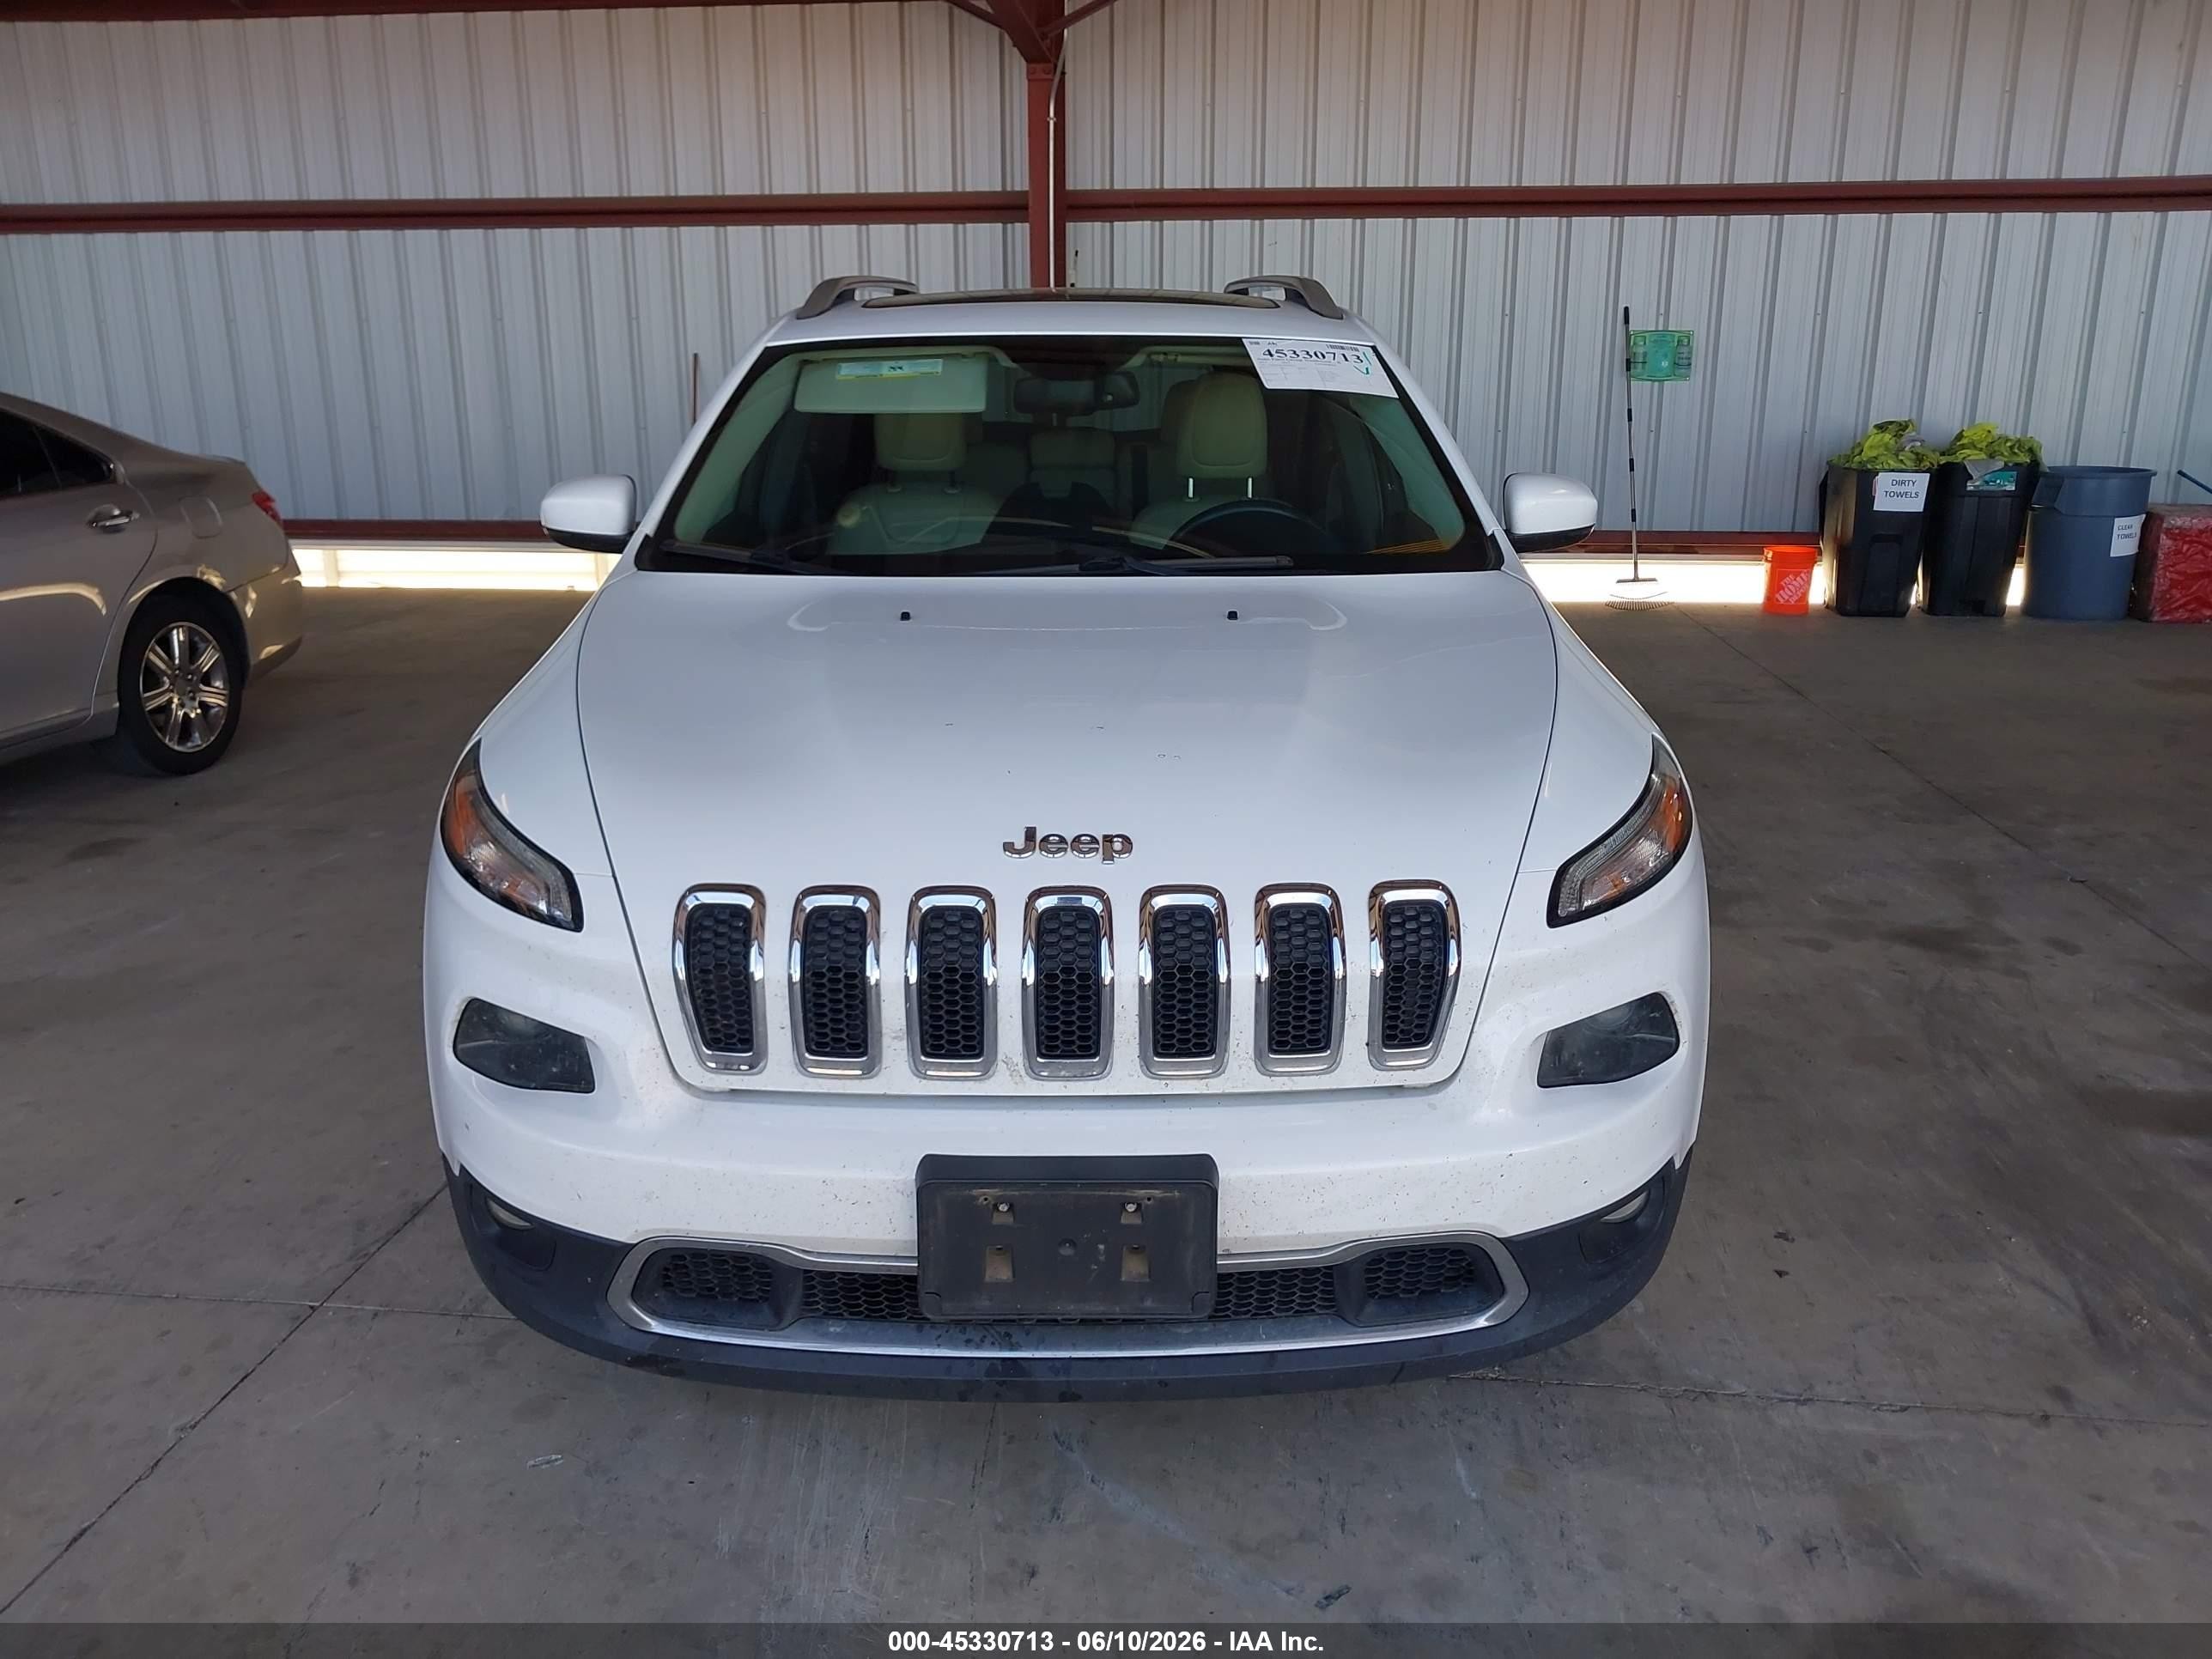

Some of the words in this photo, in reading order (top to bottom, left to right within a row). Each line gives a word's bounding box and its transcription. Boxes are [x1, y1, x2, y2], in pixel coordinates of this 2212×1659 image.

[1263, 348, 1364, 364] 45330713
[1883, 490, 1920, 499] TOWELS
[1776, 570, 1810, 604] HOME
[1003, 826, 1133, 866] Jeep
